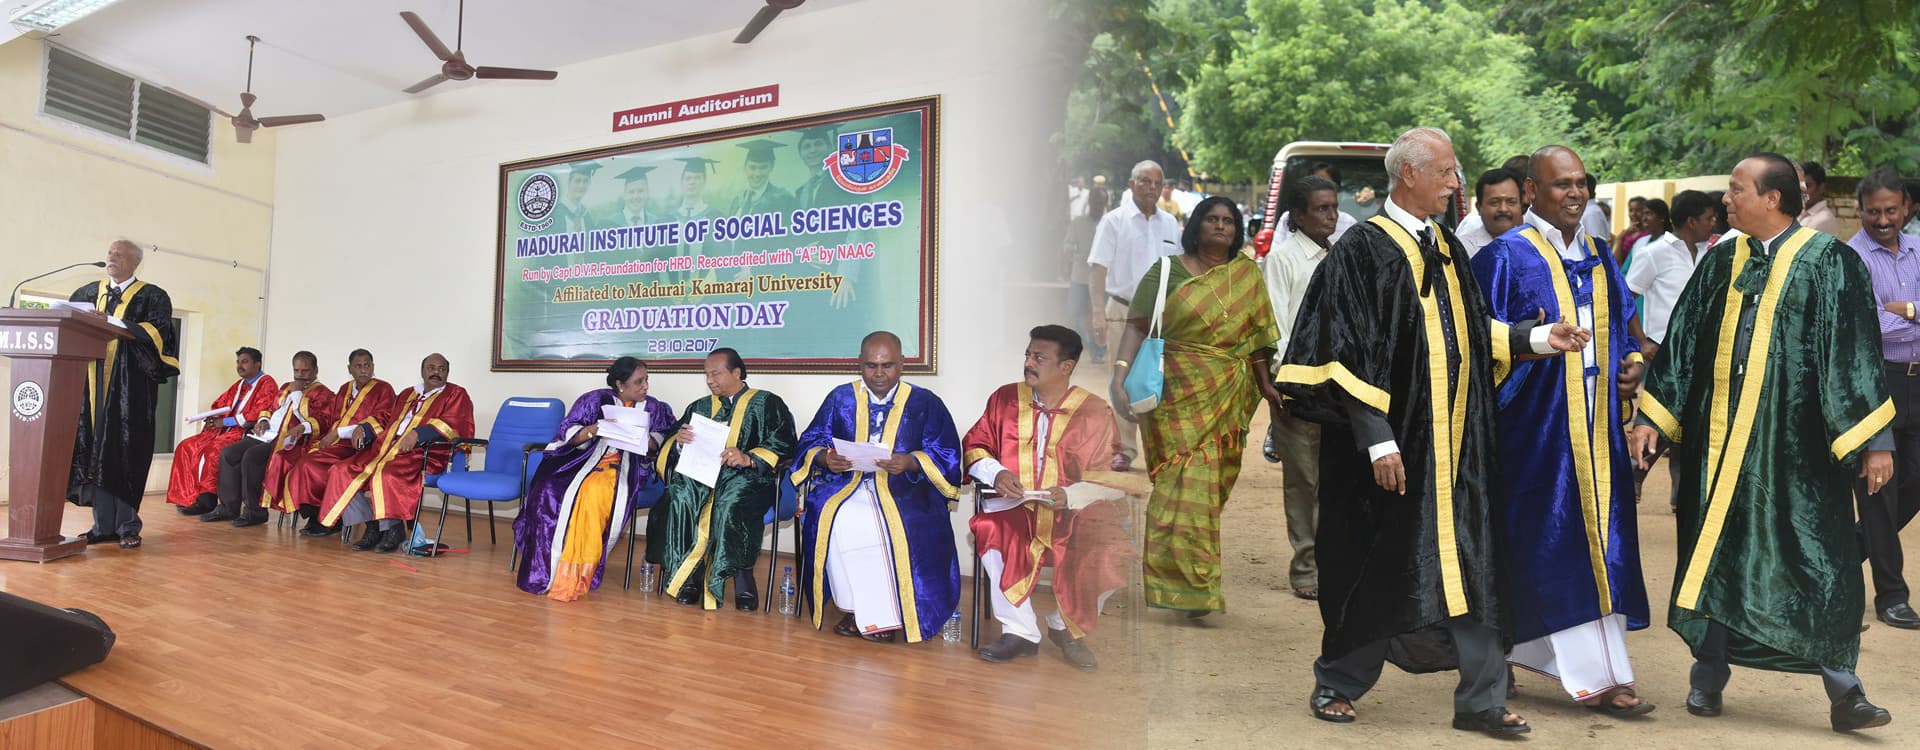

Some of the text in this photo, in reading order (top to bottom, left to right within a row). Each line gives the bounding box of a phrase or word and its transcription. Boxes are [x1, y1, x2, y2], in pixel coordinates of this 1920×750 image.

[618, 92, 772, 127] Alumni Auditorium
[516, 202, 902, 257] MADURAI INSTITUTE OF SOCIAL SCIENCES
[522, 269, 538, 281] Run
[541, 268, 550, 282] by
[553, 267, 572, 281] Capt
[653, 259, 667, 272] for
[669, 256, 694, 271] HRD,
[697, 251, 766, 268] Reaccredited
[769, 249, 792, 264] with
[819, 247, 834, 263] by
[837, 243, 874, 259] NAAC
[553, 273, 843, 302] Affiliated to Madurai Kamaraj University
[584, 303, 786, 331] GRADUATION DAY
[648, 339, 718, 352] 28.10.2017
